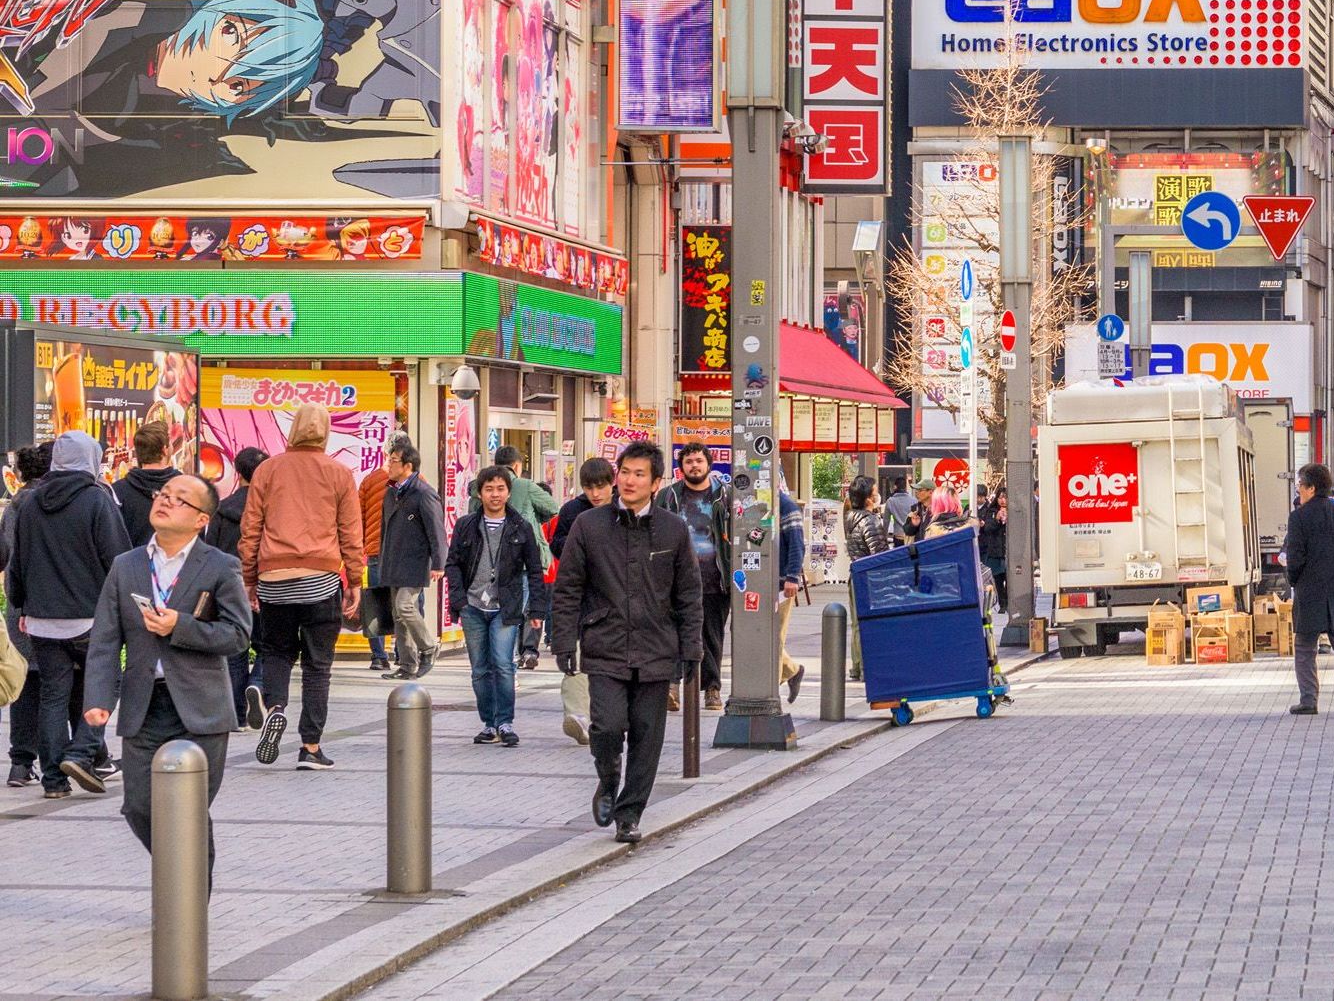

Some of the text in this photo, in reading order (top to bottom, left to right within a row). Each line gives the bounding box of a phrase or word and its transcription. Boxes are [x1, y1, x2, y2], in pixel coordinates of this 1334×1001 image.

[941, 32, 1208, 53] Home Electronics Store
[1258, 208, 1301, 224] 止まれ
[703, 272, 731, 368] アキバ商店
[1133, 569, 1160, 579] 48-67
